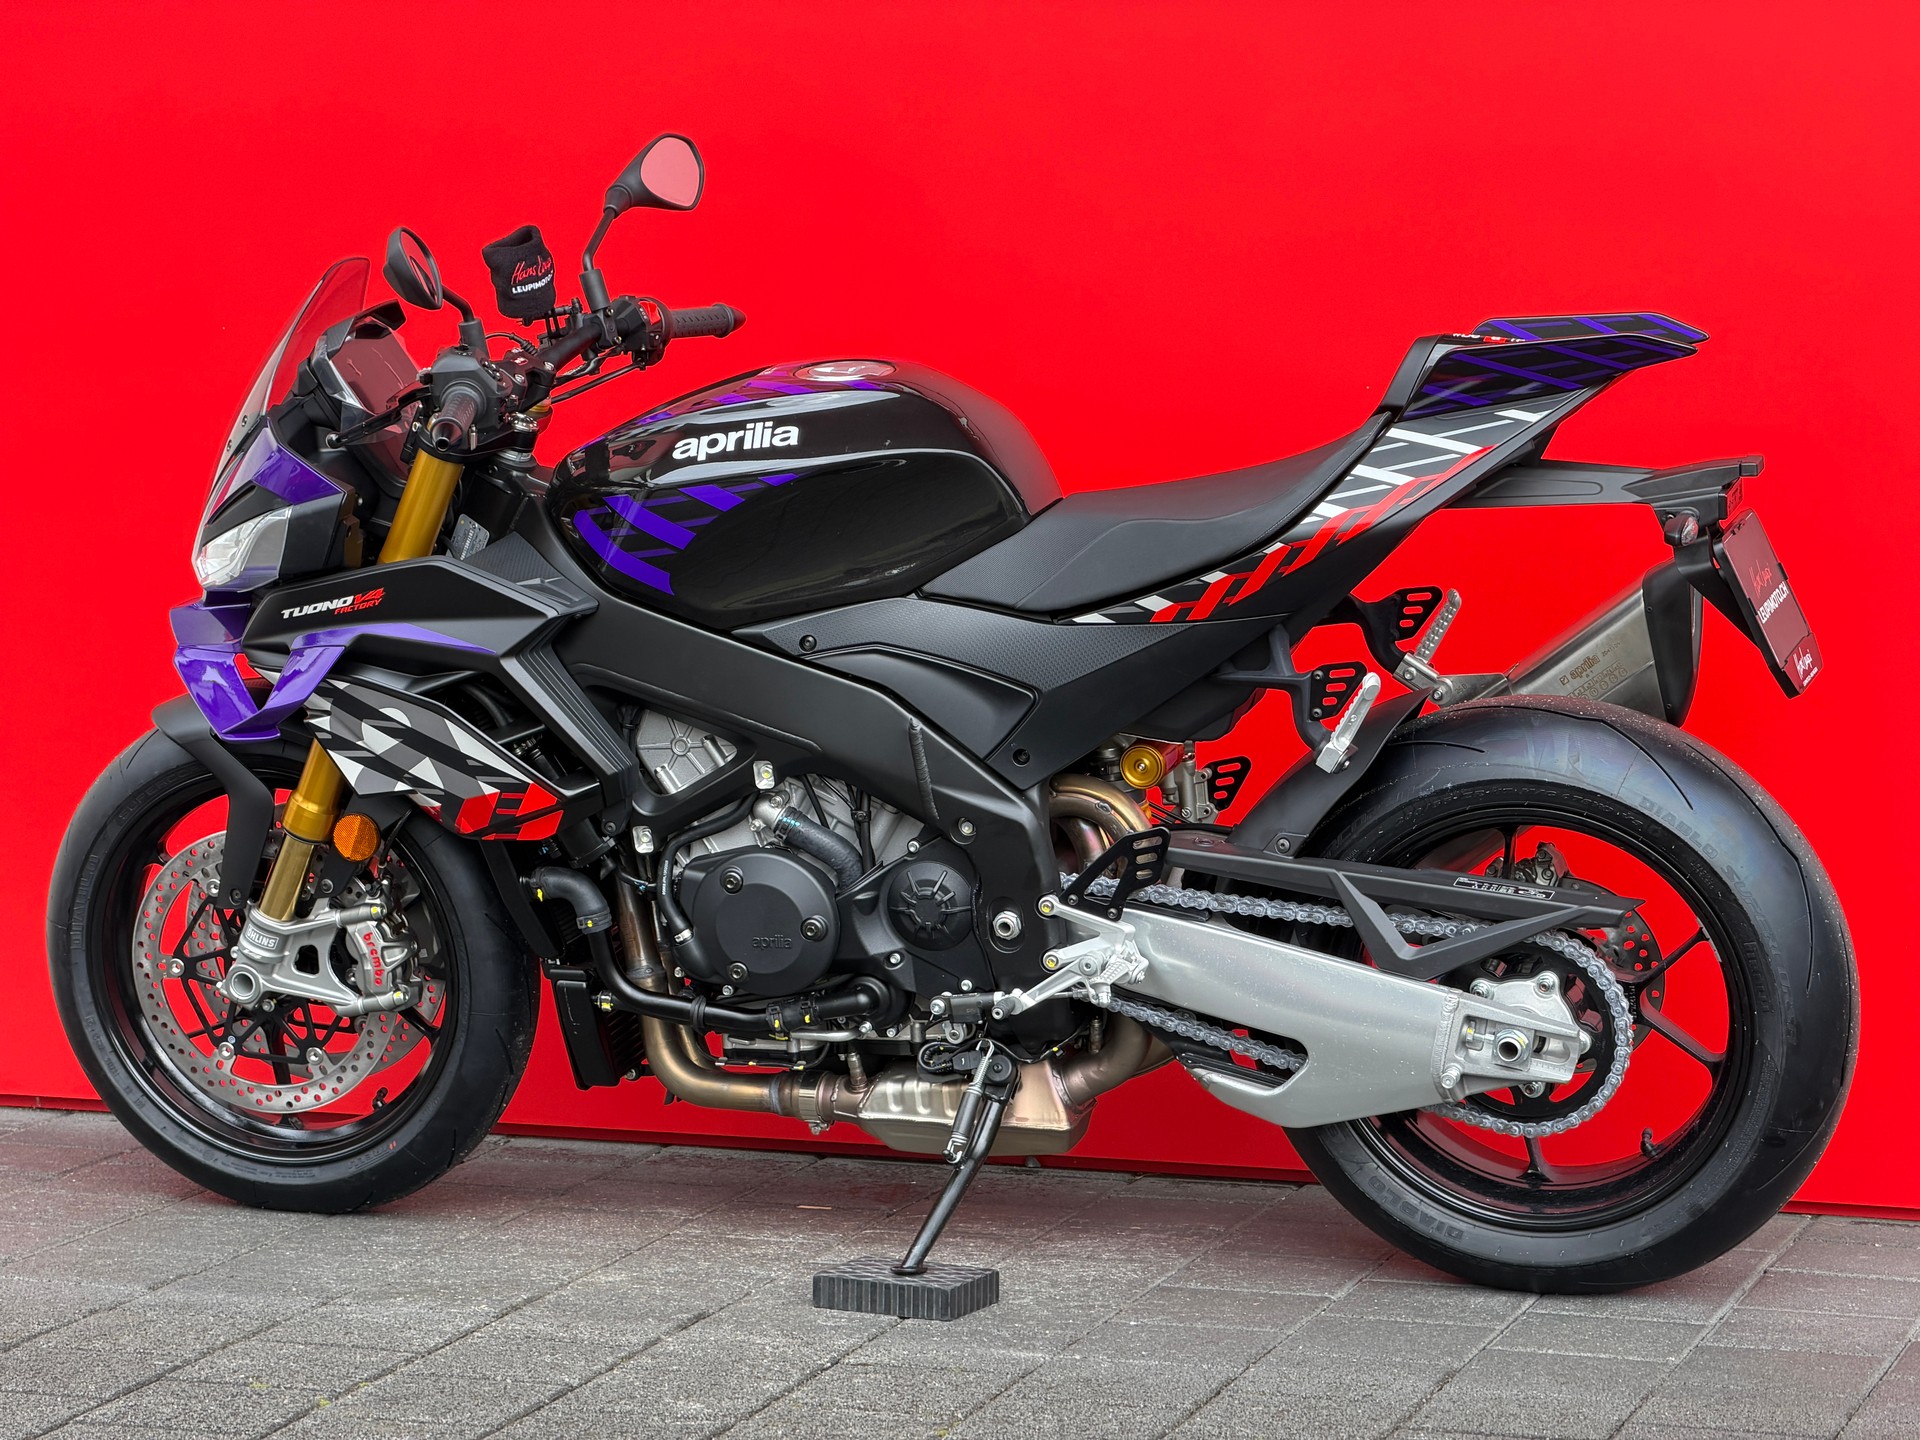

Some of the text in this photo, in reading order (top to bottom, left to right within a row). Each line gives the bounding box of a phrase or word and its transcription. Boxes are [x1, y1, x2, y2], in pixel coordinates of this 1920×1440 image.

[511, 261, 537, 285] Hans
[672, 421, 800, 461] aprilia
[281, 587, 386, 619] TUONO V4
[334, 598, 383, 615] FACTORY
[1757, 581, 1790, 624] LEUPIMOTO.CH
[1569, 653, 1601, 680] aprilia
[1638, 796, 1720, 860] DIABLO
[363, 931, 385, 987] brembo
[752, 934, 792, 951] aprilia
[1367, 1175, 1465, 1240] DIABLO
